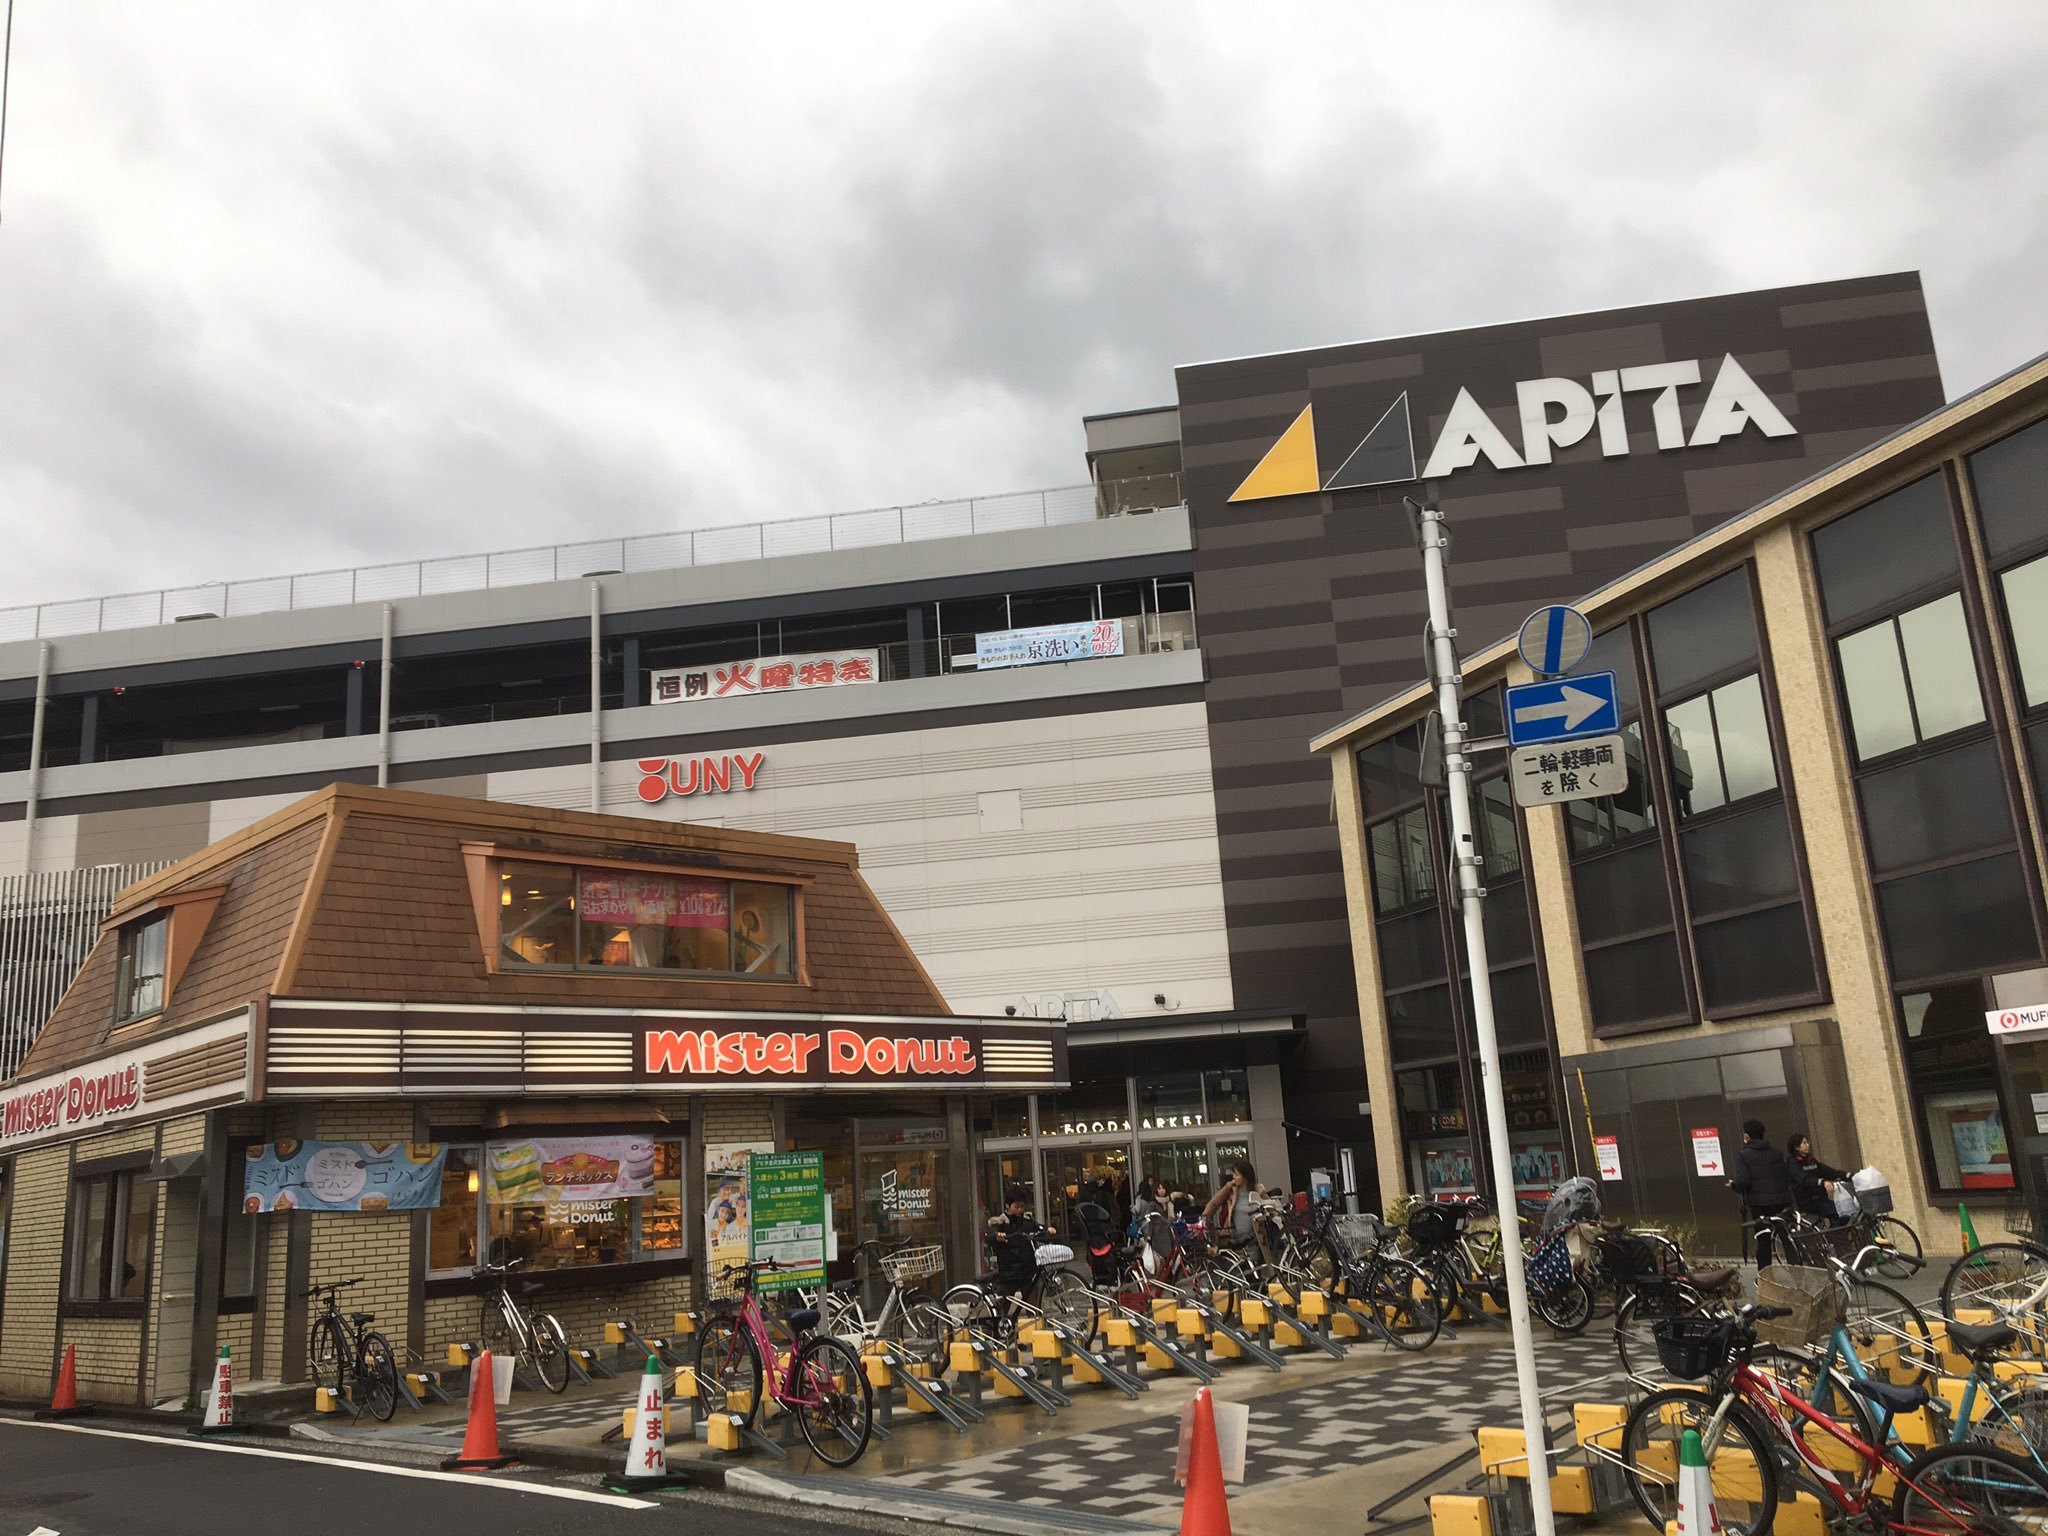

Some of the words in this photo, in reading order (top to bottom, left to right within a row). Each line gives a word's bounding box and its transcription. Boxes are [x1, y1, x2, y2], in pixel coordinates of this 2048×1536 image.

[1421, 352, 1798, 479] APITA
[1027, 638, 1080, 659] 京洗い
[1091, 641, 1119, 655] OFF
[670, 752, 764, 796] UNY
[1540, 773, 1600, 796] を除く
[1015, 988, 1123, 1023] APITA
[2020, 1010, 2048, 1024] MUF
[827, 1030, 977, 1075] Donut
[66, 1064, 140, 1123] Donut
[1064, 1119, 1118, 1135] FOOD
[255, 1163, 301, 1188] ミスド
[372, 1165, 436, 1186] ゴハン
[545, 1171, 614, 1184] ランチボックス
[898, 1199, 931, 1210] Donut
[570, 1211, 615, 1224] Donut
[217, 1364, 234, 1426] 駐車禁止
[644, 1388, 664, 1470] 止まれ
